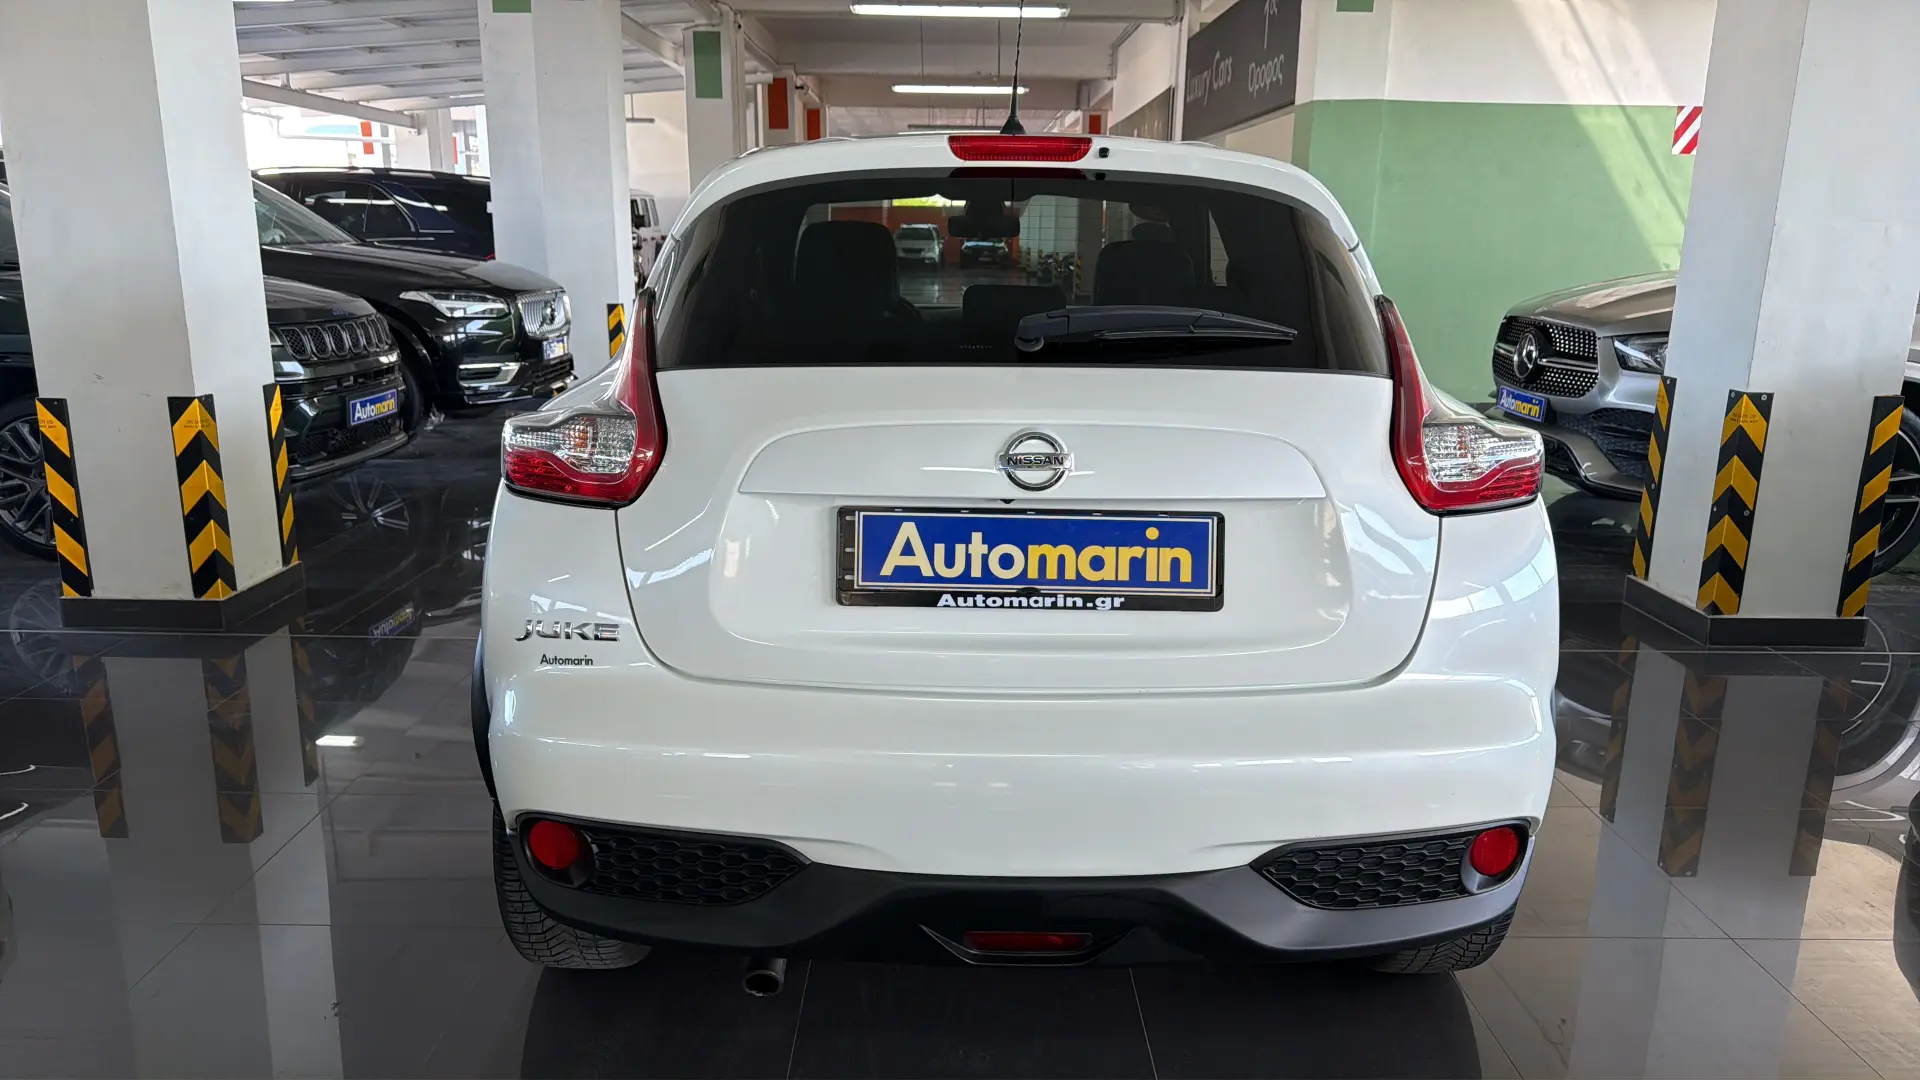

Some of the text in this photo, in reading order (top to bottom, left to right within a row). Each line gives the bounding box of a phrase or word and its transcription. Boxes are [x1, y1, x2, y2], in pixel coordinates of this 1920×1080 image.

[1212, 50, 1233, 91] Cars
[354, 394, 395, 422] Automarin
[1500, 389, 1540, 418] Automarin
[1006, 455, 1064, 466] NISSAN
[879, 521, 1192, 583] Automarin
[936, 593, 1125, 611] Automarin.gr
[514, 619, 621, 642] JUKE
[539, 653, 594, 666] Automarin
